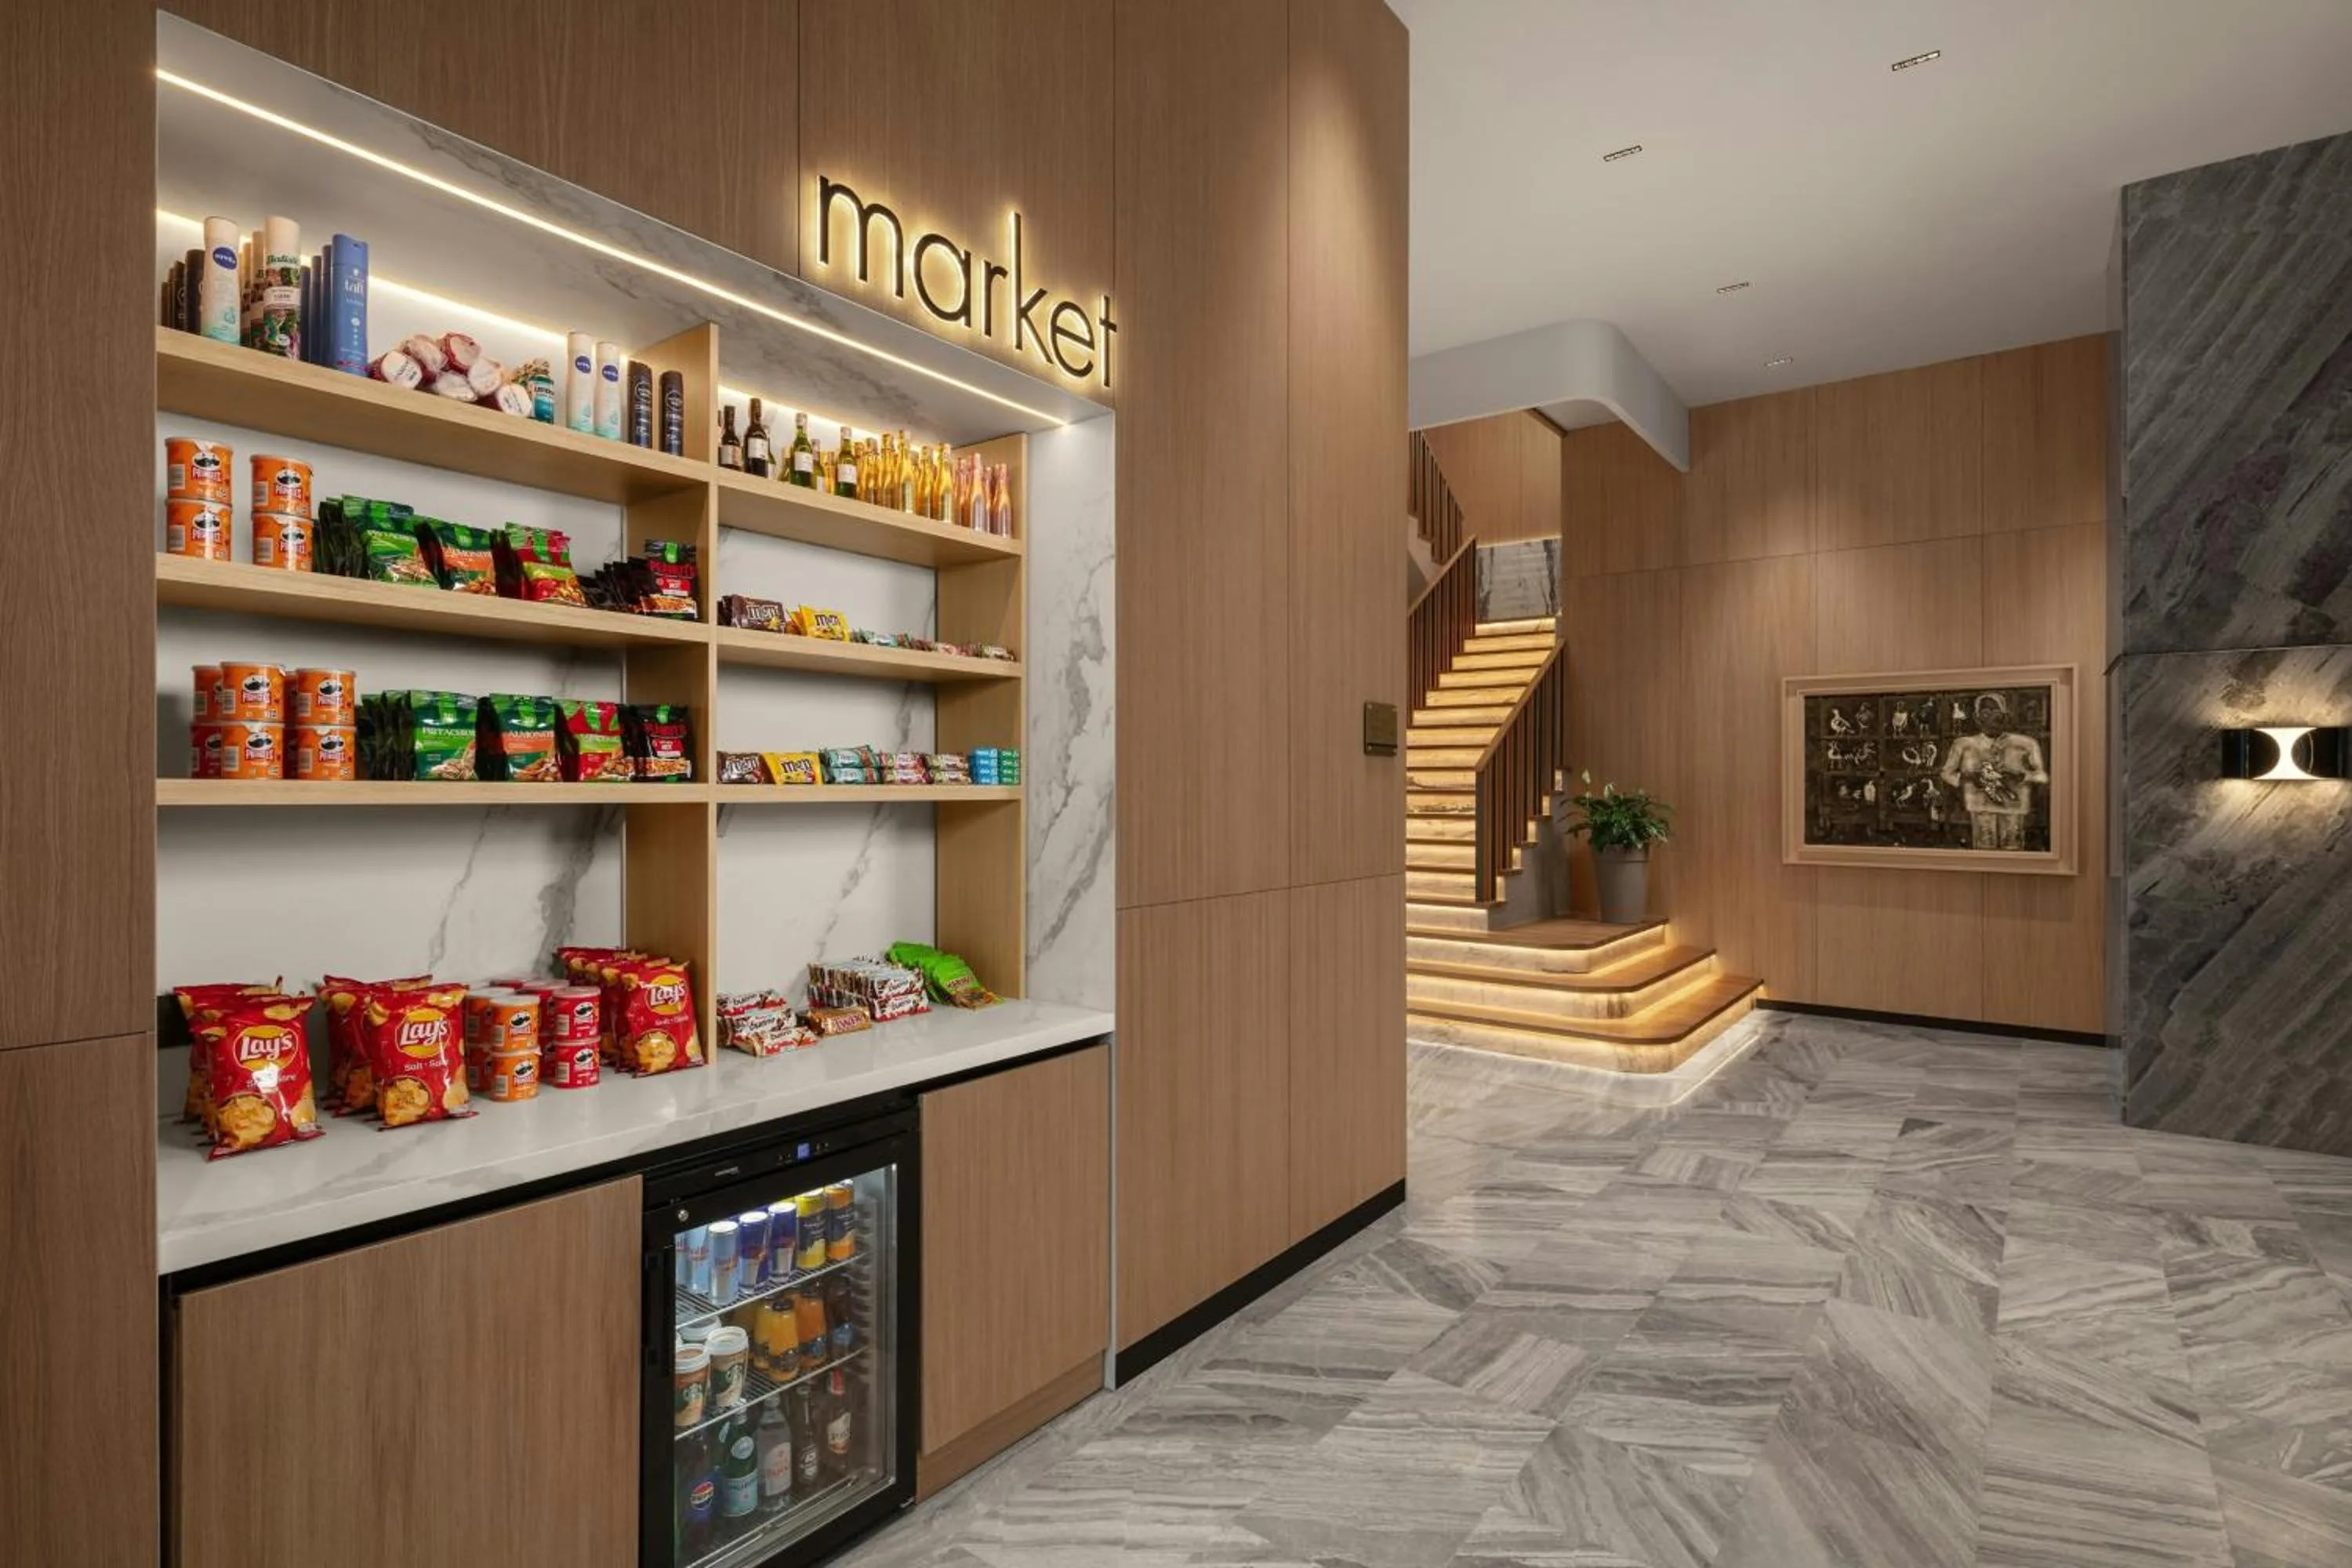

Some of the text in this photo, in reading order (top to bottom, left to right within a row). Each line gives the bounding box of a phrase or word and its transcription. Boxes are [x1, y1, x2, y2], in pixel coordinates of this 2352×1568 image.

[817, 175, 1117, 387] market
[400, 1018, 448, 1046] Lay's
[240, 1033, 293, 1062] Lay's
